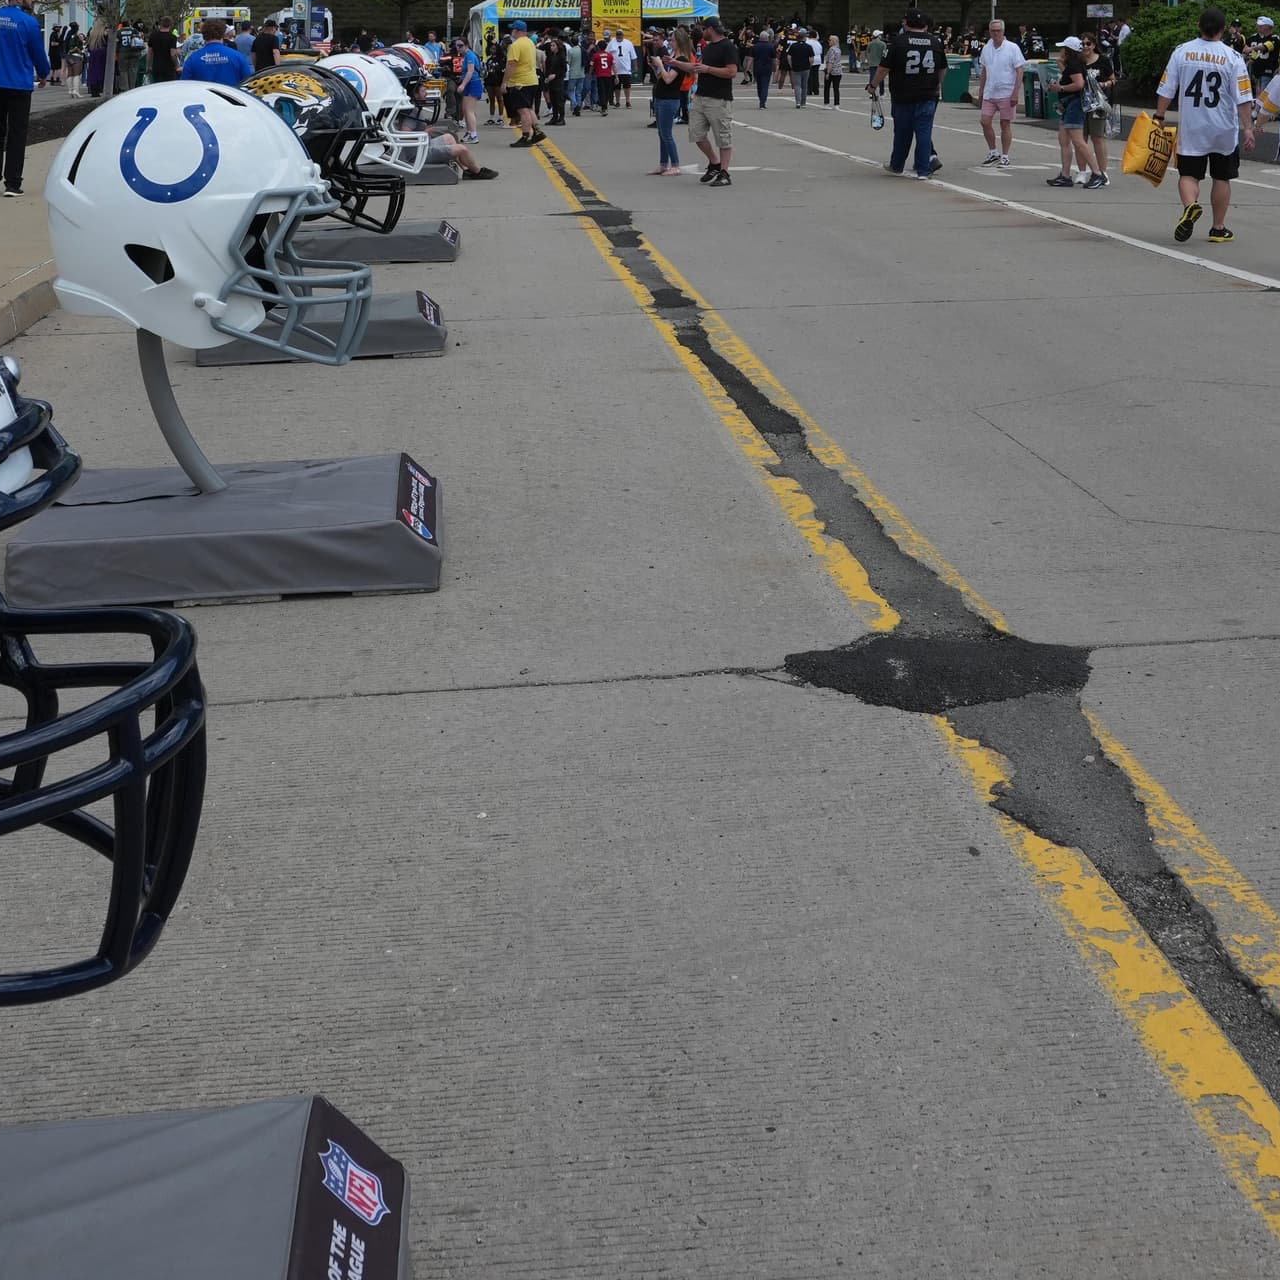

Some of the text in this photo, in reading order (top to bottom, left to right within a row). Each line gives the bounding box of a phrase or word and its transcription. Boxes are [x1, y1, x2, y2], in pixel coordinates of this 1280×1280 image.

[600, 57, 608, 69] 5
[618, 46, 624, 57] 1
[905, 50, 935, 74] 24
[1185, 51, 1226, 65] POLAMALU
[1184, 70, 1222, 108] 43
[346, 1169, 378, 1219] NFL
[330, 1219, 347, 1258] THE
[347, 1234, 365, 1280] AGUE
